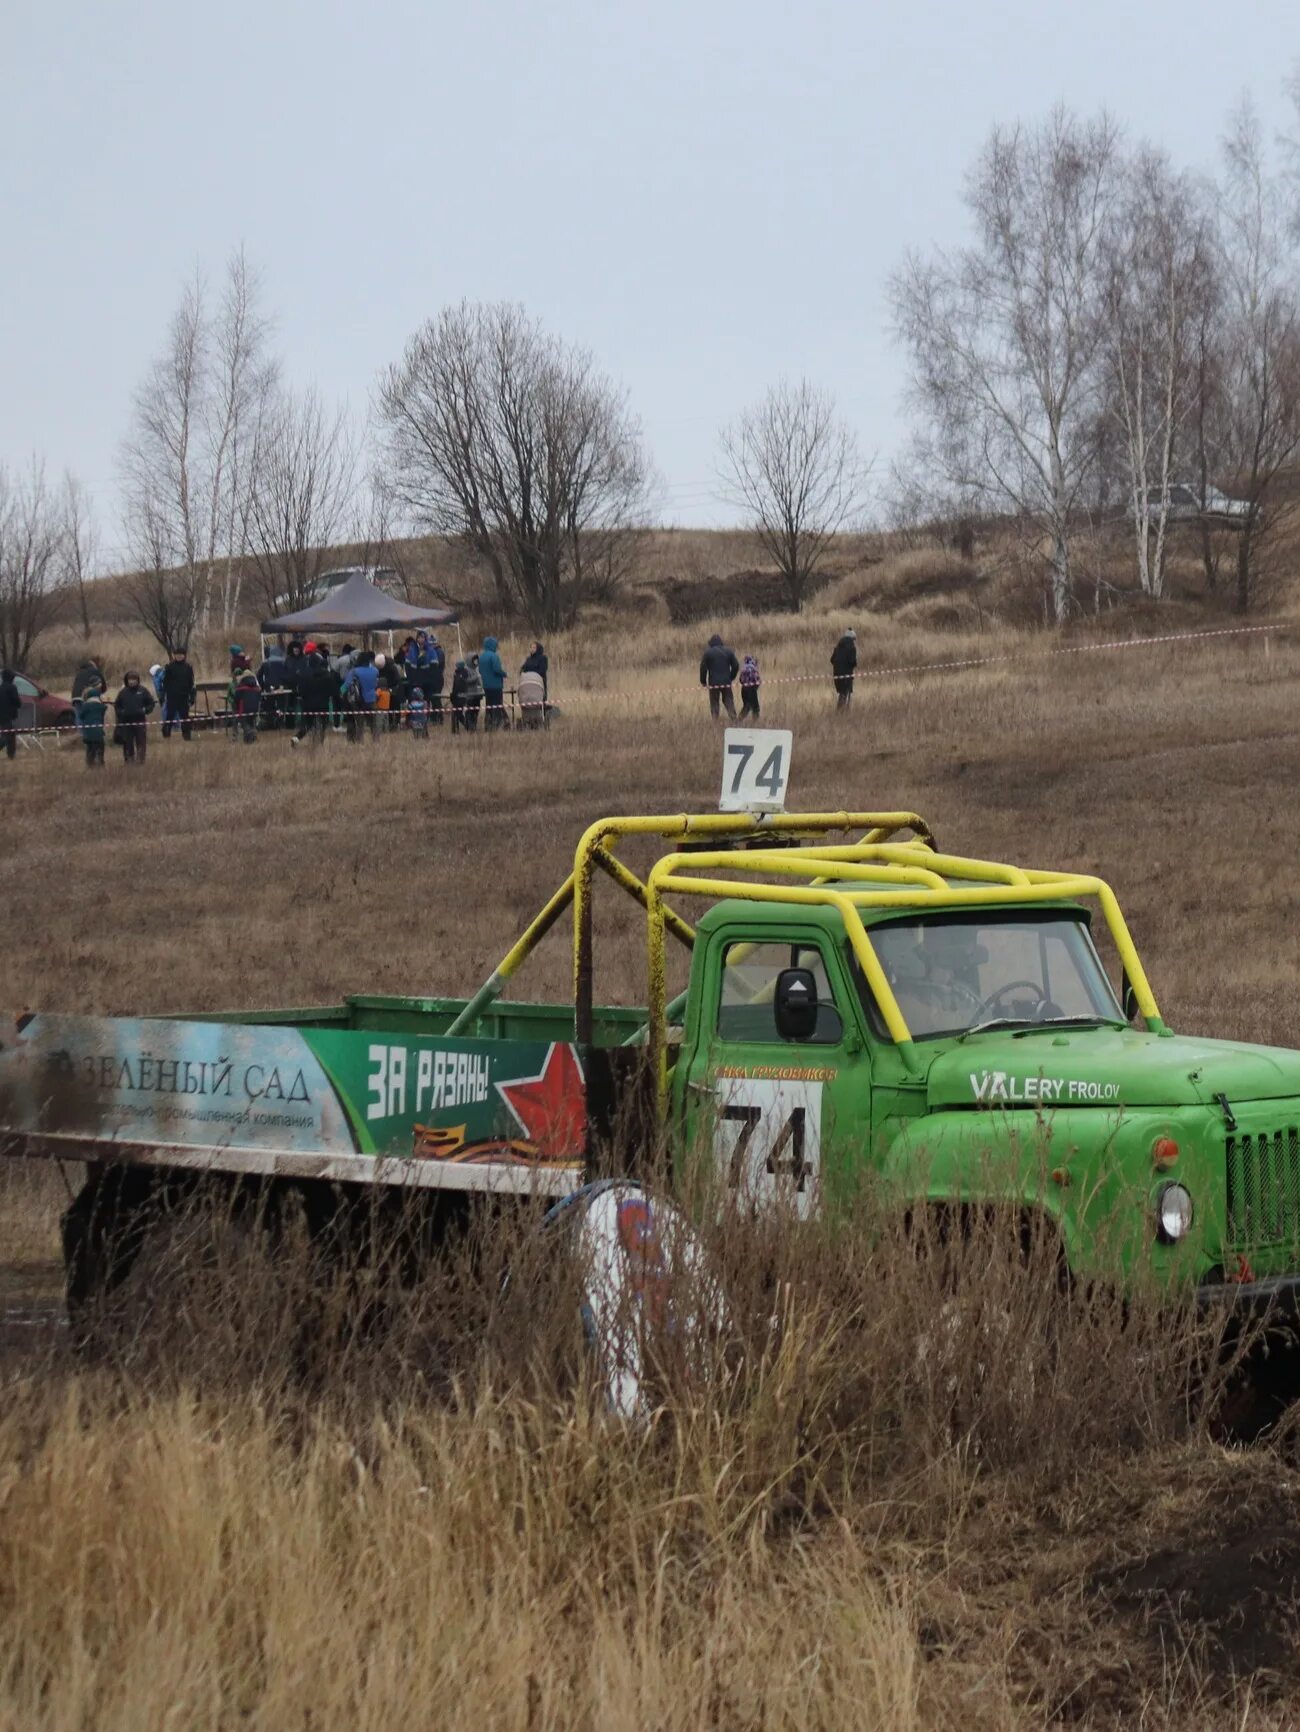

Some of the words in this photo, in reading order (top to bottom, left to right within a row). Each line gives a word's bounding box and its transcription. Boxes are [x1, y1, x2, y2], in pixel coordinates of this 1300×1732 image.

[727, 744, 784, 797] 74
[82, 1051, 233, 1097] ЗЕЛЁНЫЙ
[243, 1064, 312, 1105] САД
[367, 1044, 407, 1120] ЗА
[416, 1049, 489, 1113] РЯЗАНЬ!
[969, 1069, 1064, 1100] VALERY
[1068, 1080, 1120, 1099] FROLOV
[252, 1112, 315, 1129] компания
[720, 1104, 813, 1193] 74
